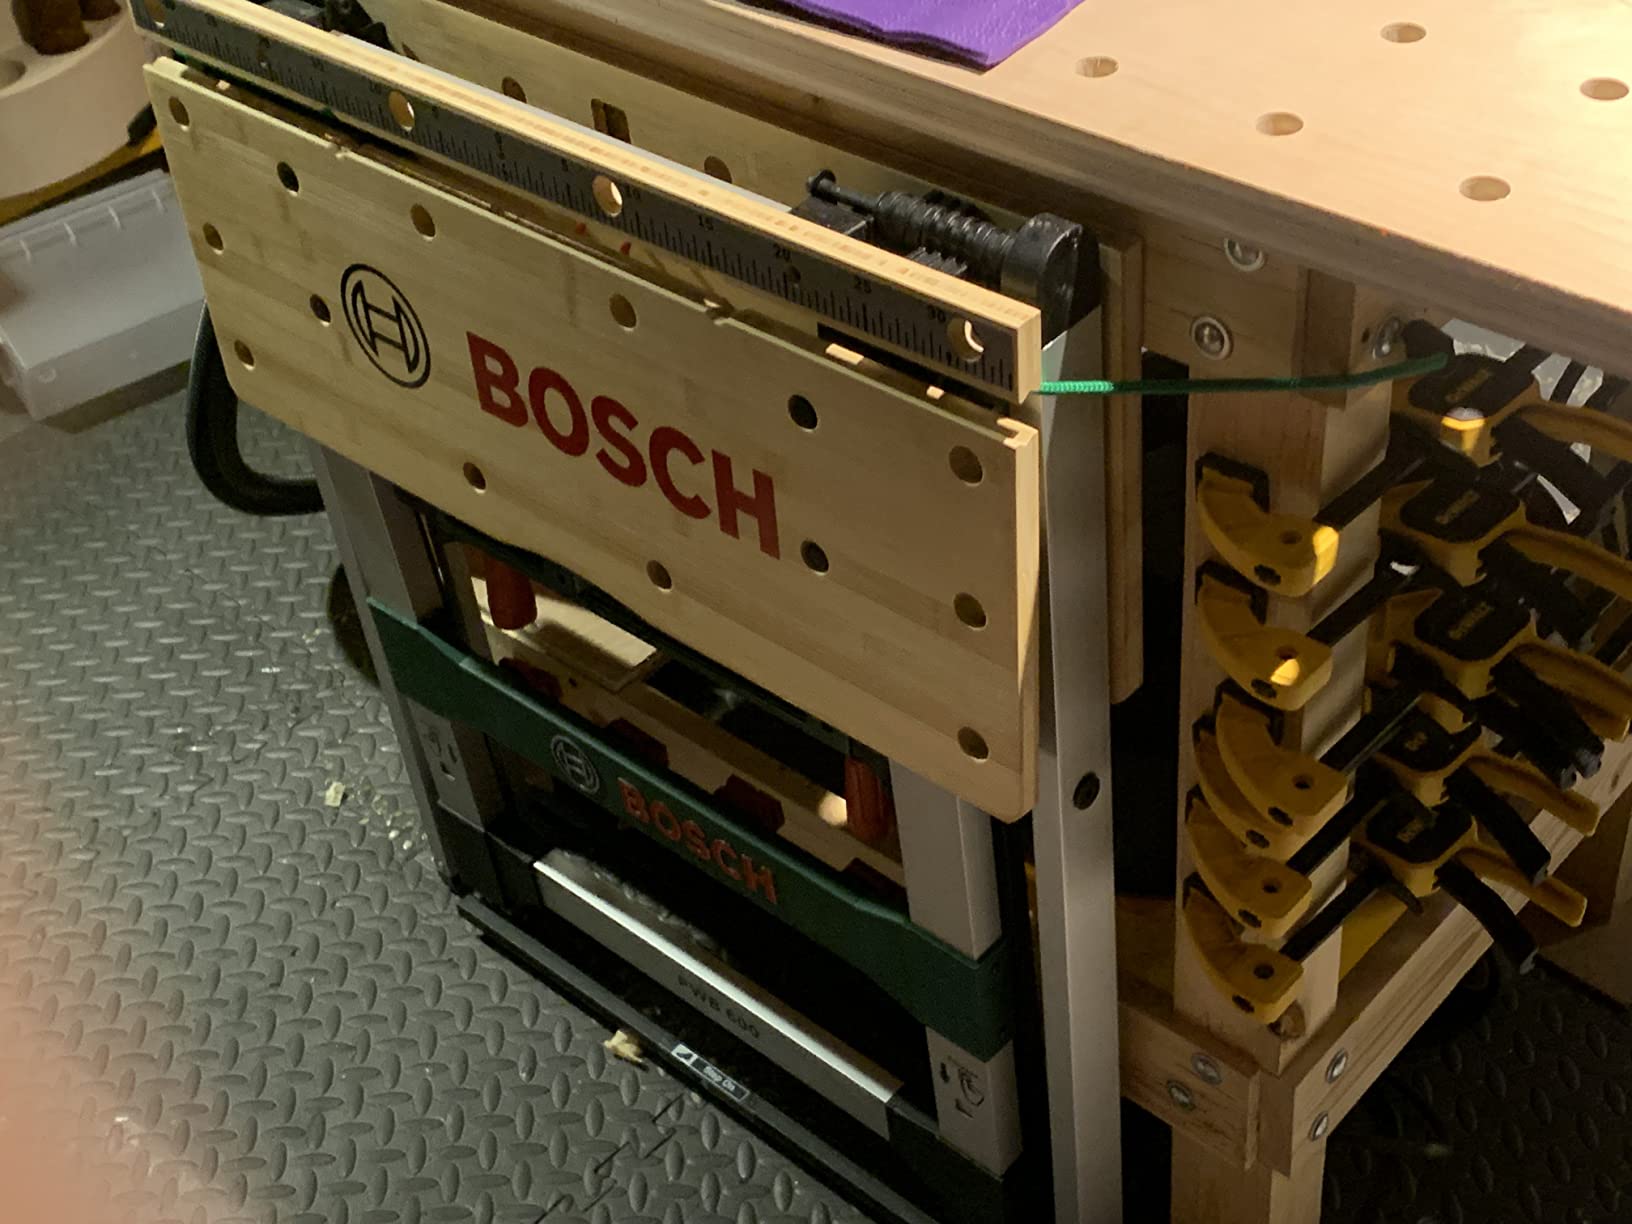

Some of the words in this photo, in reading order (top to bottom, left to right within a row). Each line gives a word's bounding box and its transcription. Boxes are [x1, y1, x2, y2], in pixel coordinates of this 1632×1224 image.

[772, 243, 791, 263] 20
[853, 275, 872, 294] 25
[926, 304, 947, 324] 30
[466, 331, 781, 560] BOSCH
[617, 777, 777, 904] BOSCH
